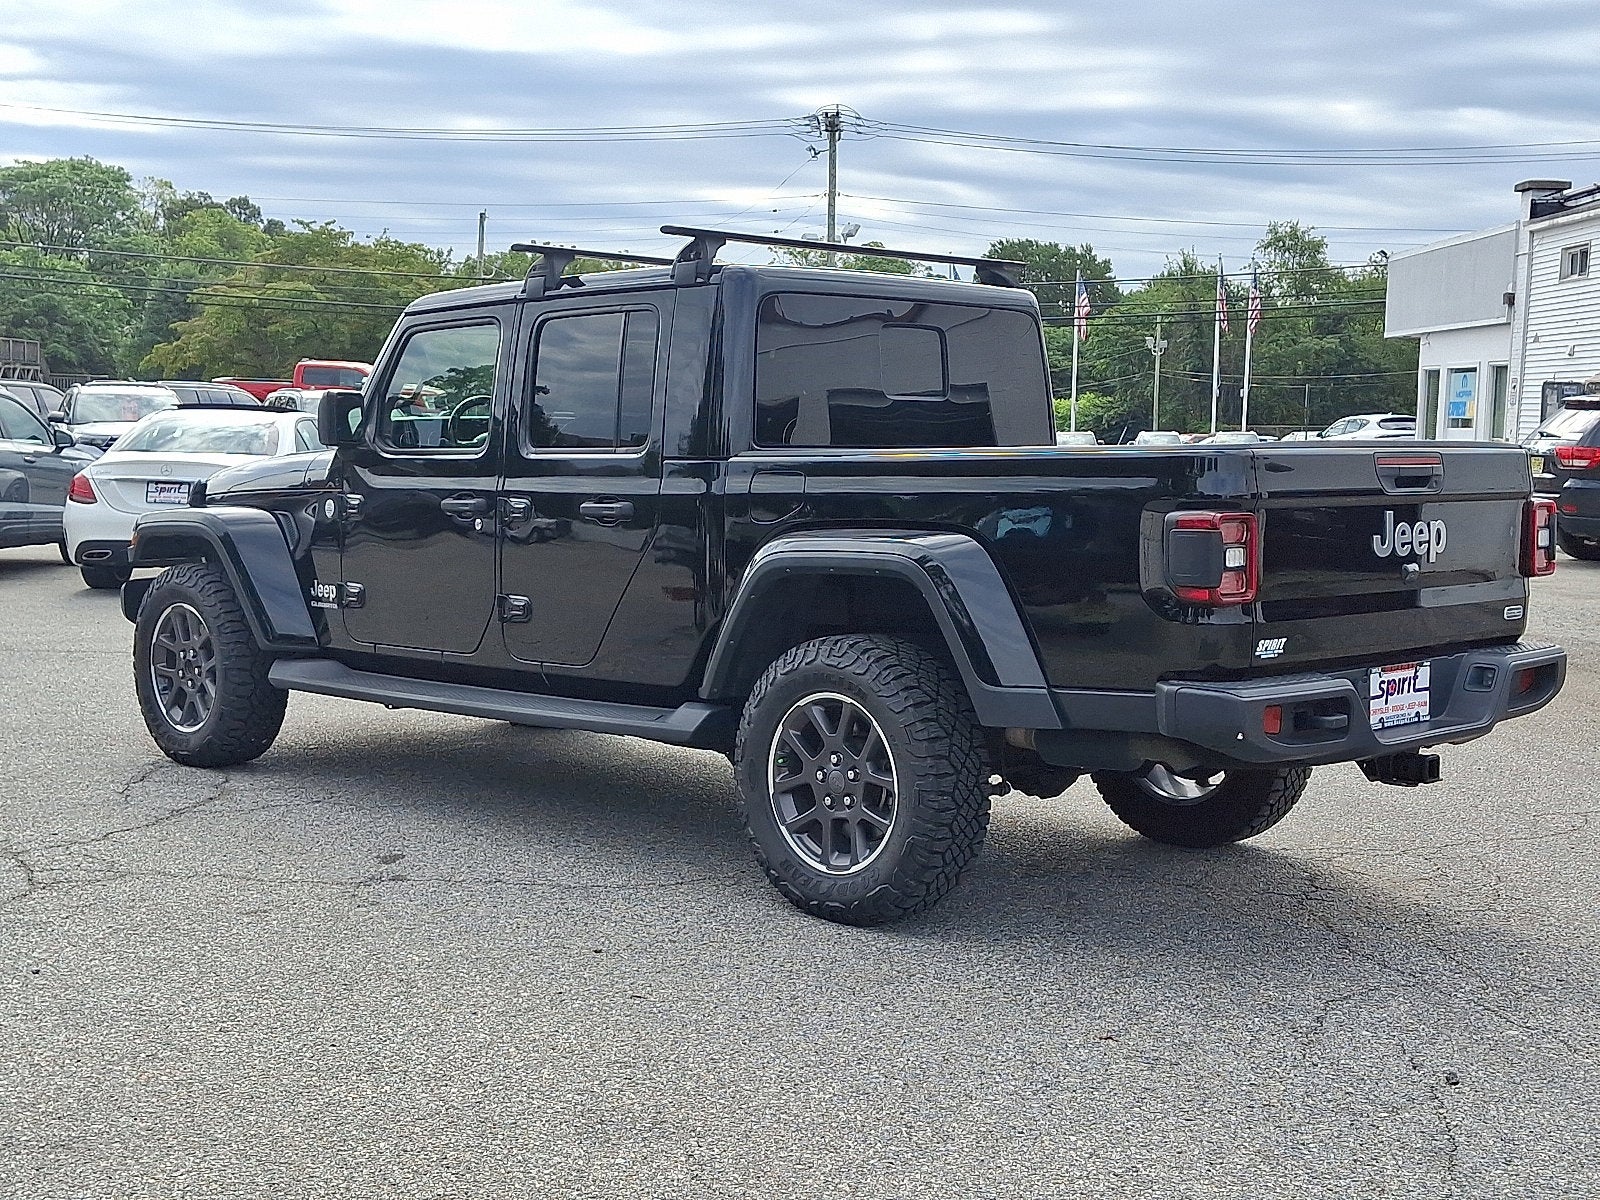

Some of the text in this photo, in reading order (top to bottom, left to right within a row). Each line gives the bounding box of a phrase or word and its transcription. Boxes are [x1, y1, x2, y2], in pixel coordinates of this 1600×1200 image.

[154, 483, 182, 496] spirit
[1373, 511, 1447, 563] Jeep
[310, 579, 337, 602] Jeep
[1256, 637, 1288, 651] SPIRIT
[1378, 671, 1420, 705] spirit
